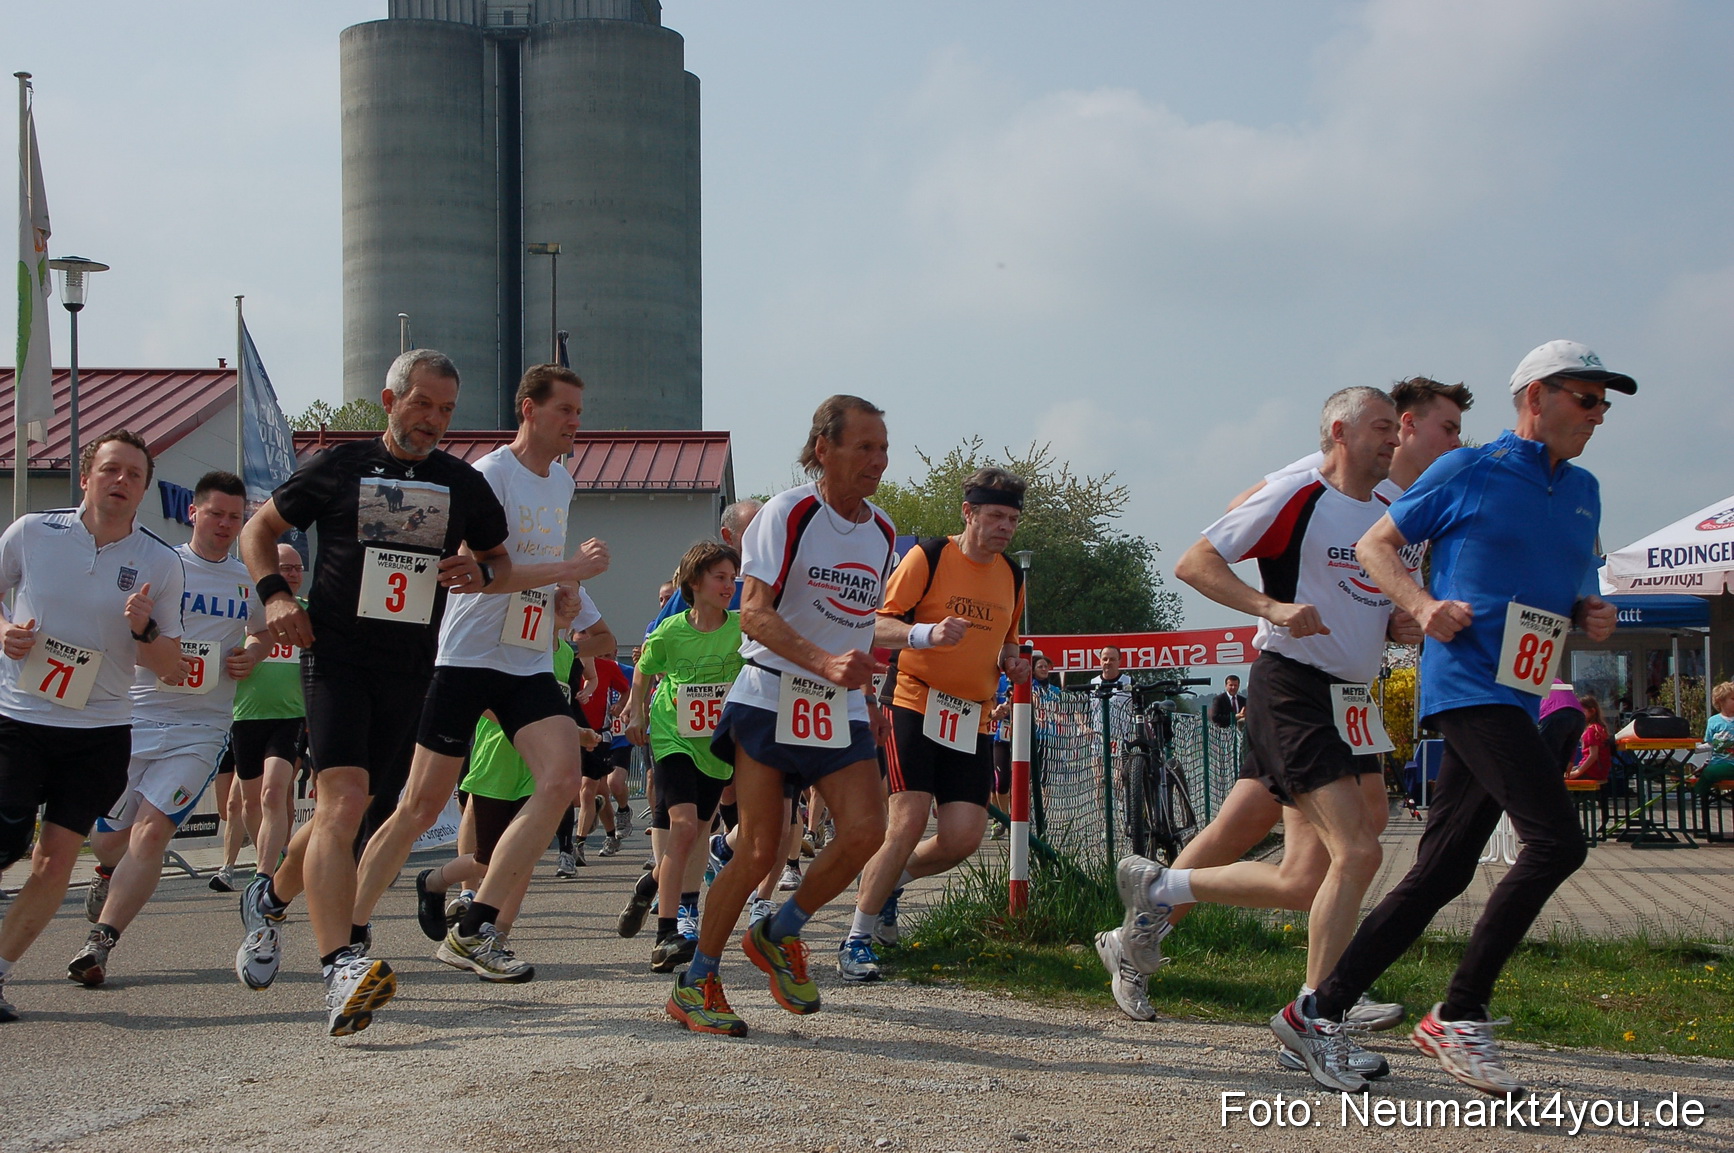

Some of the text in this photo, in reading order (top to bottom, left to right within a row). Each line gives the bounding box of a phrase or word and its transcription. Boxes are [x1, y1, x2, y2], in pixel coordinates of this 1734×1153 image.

[265, 444, 291, 471] V40
[377, 552, 414, 565] MEYER
[1327, 546, 1358, 562] GER
[1647, 541, 1734, 569] ERDINGE
[377, 561, 413, 571] WERBUNG
[807, 580, 841, 592] Autohaus
[808, 566, 877, 593] GERHART
[1338, 580, 1351, 595] Das
[386, 572, 408, 613] 3
[521, 589, 542, 599] MEYER
[838, 587, 877, 608] JÄNIG
[812, 599, 825, 614] Das
[954, 602, 994, 621] OEXL
[1615, 607, 1643, 622] att
[521, 605, 543, 641] 17
[1521, 610, 1554, 627] MEYER
[45, 644, 75, 661] WERBUNG
[46, 638, 78, 656] MEYER
[181, 642, 197, 650] YER
[1513, 632, 1554, 686] 83
[39, 657, 75, 699] 71
[178, 656, 205, 688] 9
[791, 685, 824, 697] WERBUNG
[792, 677, 826, 690] MEYER
[1342, 687, 1366, 696] MEYER
[936, 699, 962, 712] WERBUNG
[937, 692, 963, 707] MEYER
[690, 699, 722, 731] 35
[792, 698, 833, 741] 66
[611, 719, 621, 734] 9
[939, 709, 960, 743] 11
[1346, 705, 1374, 747] 81
